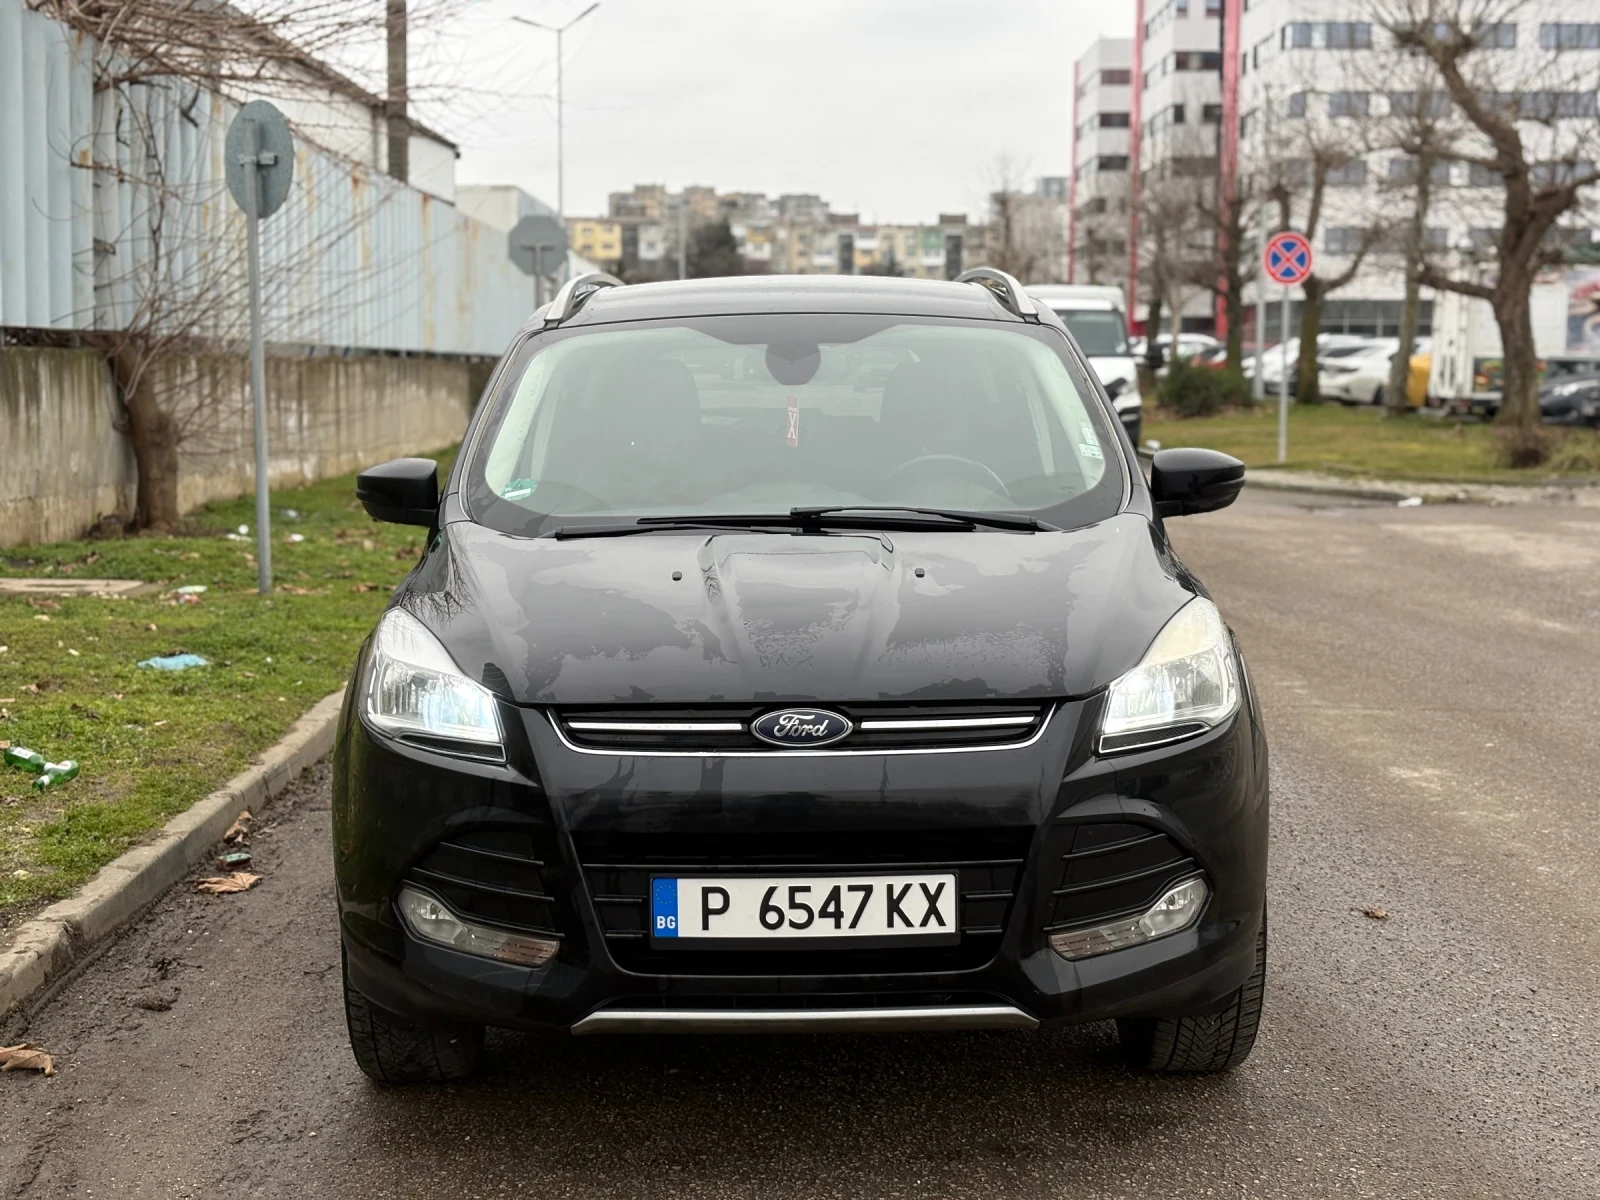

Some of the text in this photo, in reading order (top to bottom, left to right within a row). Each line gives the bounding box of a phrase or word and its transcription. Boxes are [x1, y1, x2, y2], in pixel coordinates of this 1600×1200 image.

[773, 713, 829, 737] Ford
[701, 882, 947, 931] P 6547 KX
[656, 915, 676, 929] BG
